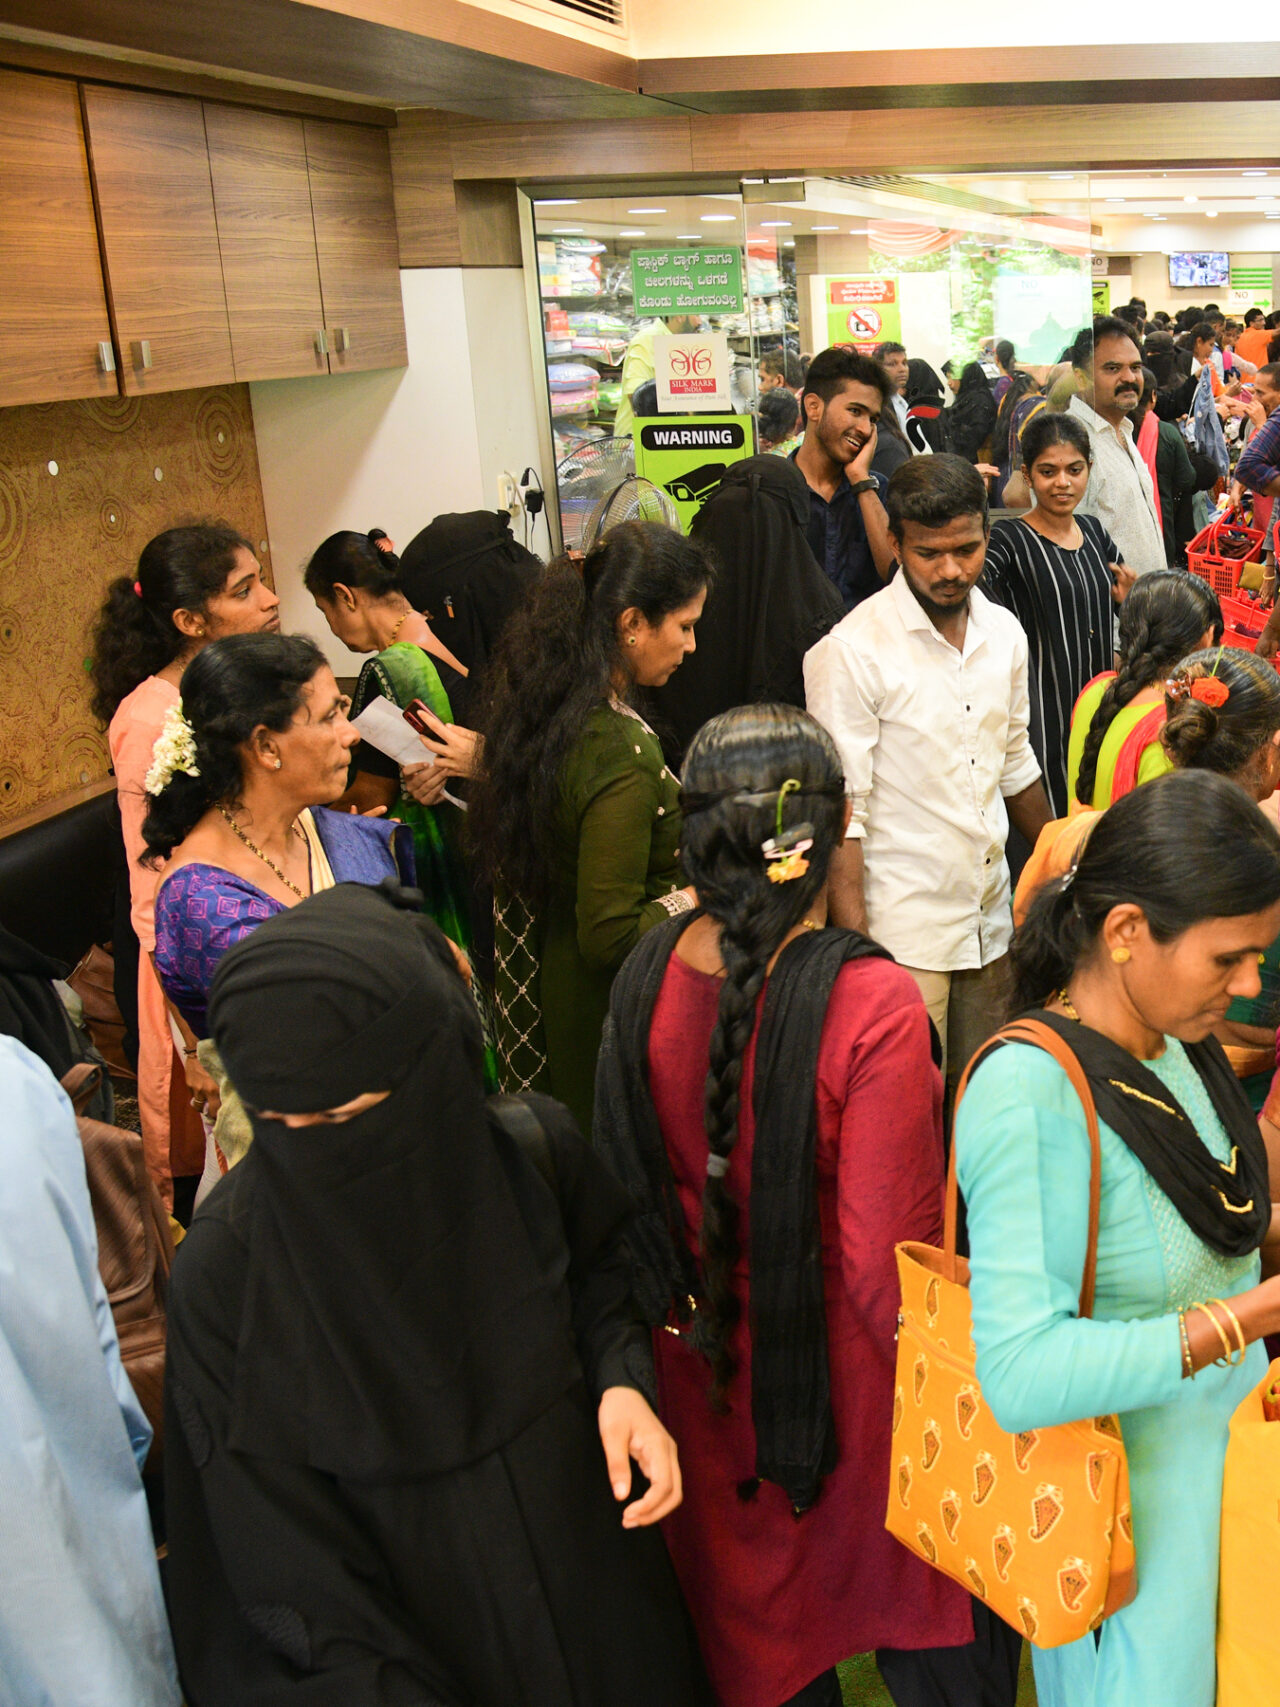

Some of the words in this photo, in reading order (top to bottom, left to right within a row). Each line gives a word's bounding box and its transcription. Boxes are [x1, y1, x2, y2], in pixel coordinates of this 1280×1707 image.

[704, 253, 733, 265] ಹಾಗೂ
[698, 272, 728, 286] ಒಳಗಡೆ
[639, 295, 672, 308] ಕೊಂಡು
[672, 380, 689, 388] SILK
[653, 430, 733, 445] WARNING
